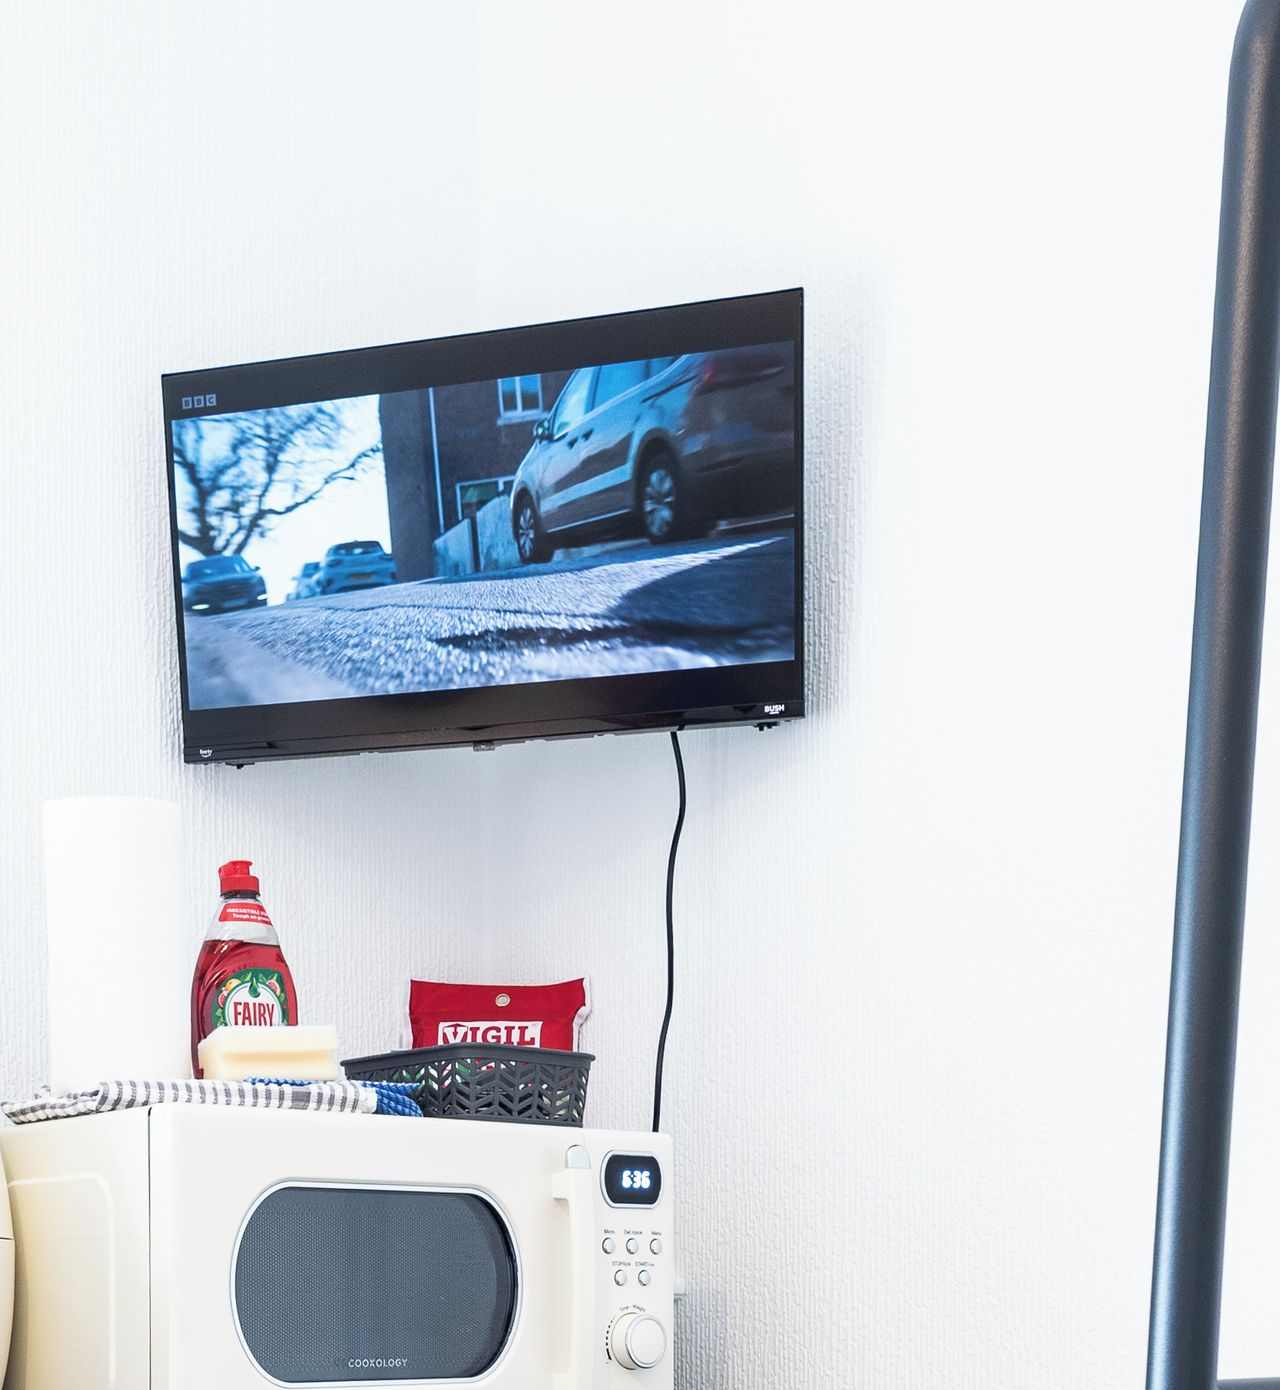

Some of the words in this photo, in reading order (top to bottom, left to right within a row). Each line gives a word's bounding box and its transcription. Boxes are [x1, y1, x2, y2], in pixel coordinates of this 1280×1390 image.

[182, 394, 217, 409] BBC
[764, 704, 785, 713] BUSH
[233, 1001, 275, 1027] FAIRY
[442, 1023, 537, 1046] VIGIL
[621, 1170, 651, 1189] 6:36
[348, 1358, 408, 1368] COOKOLOGY
